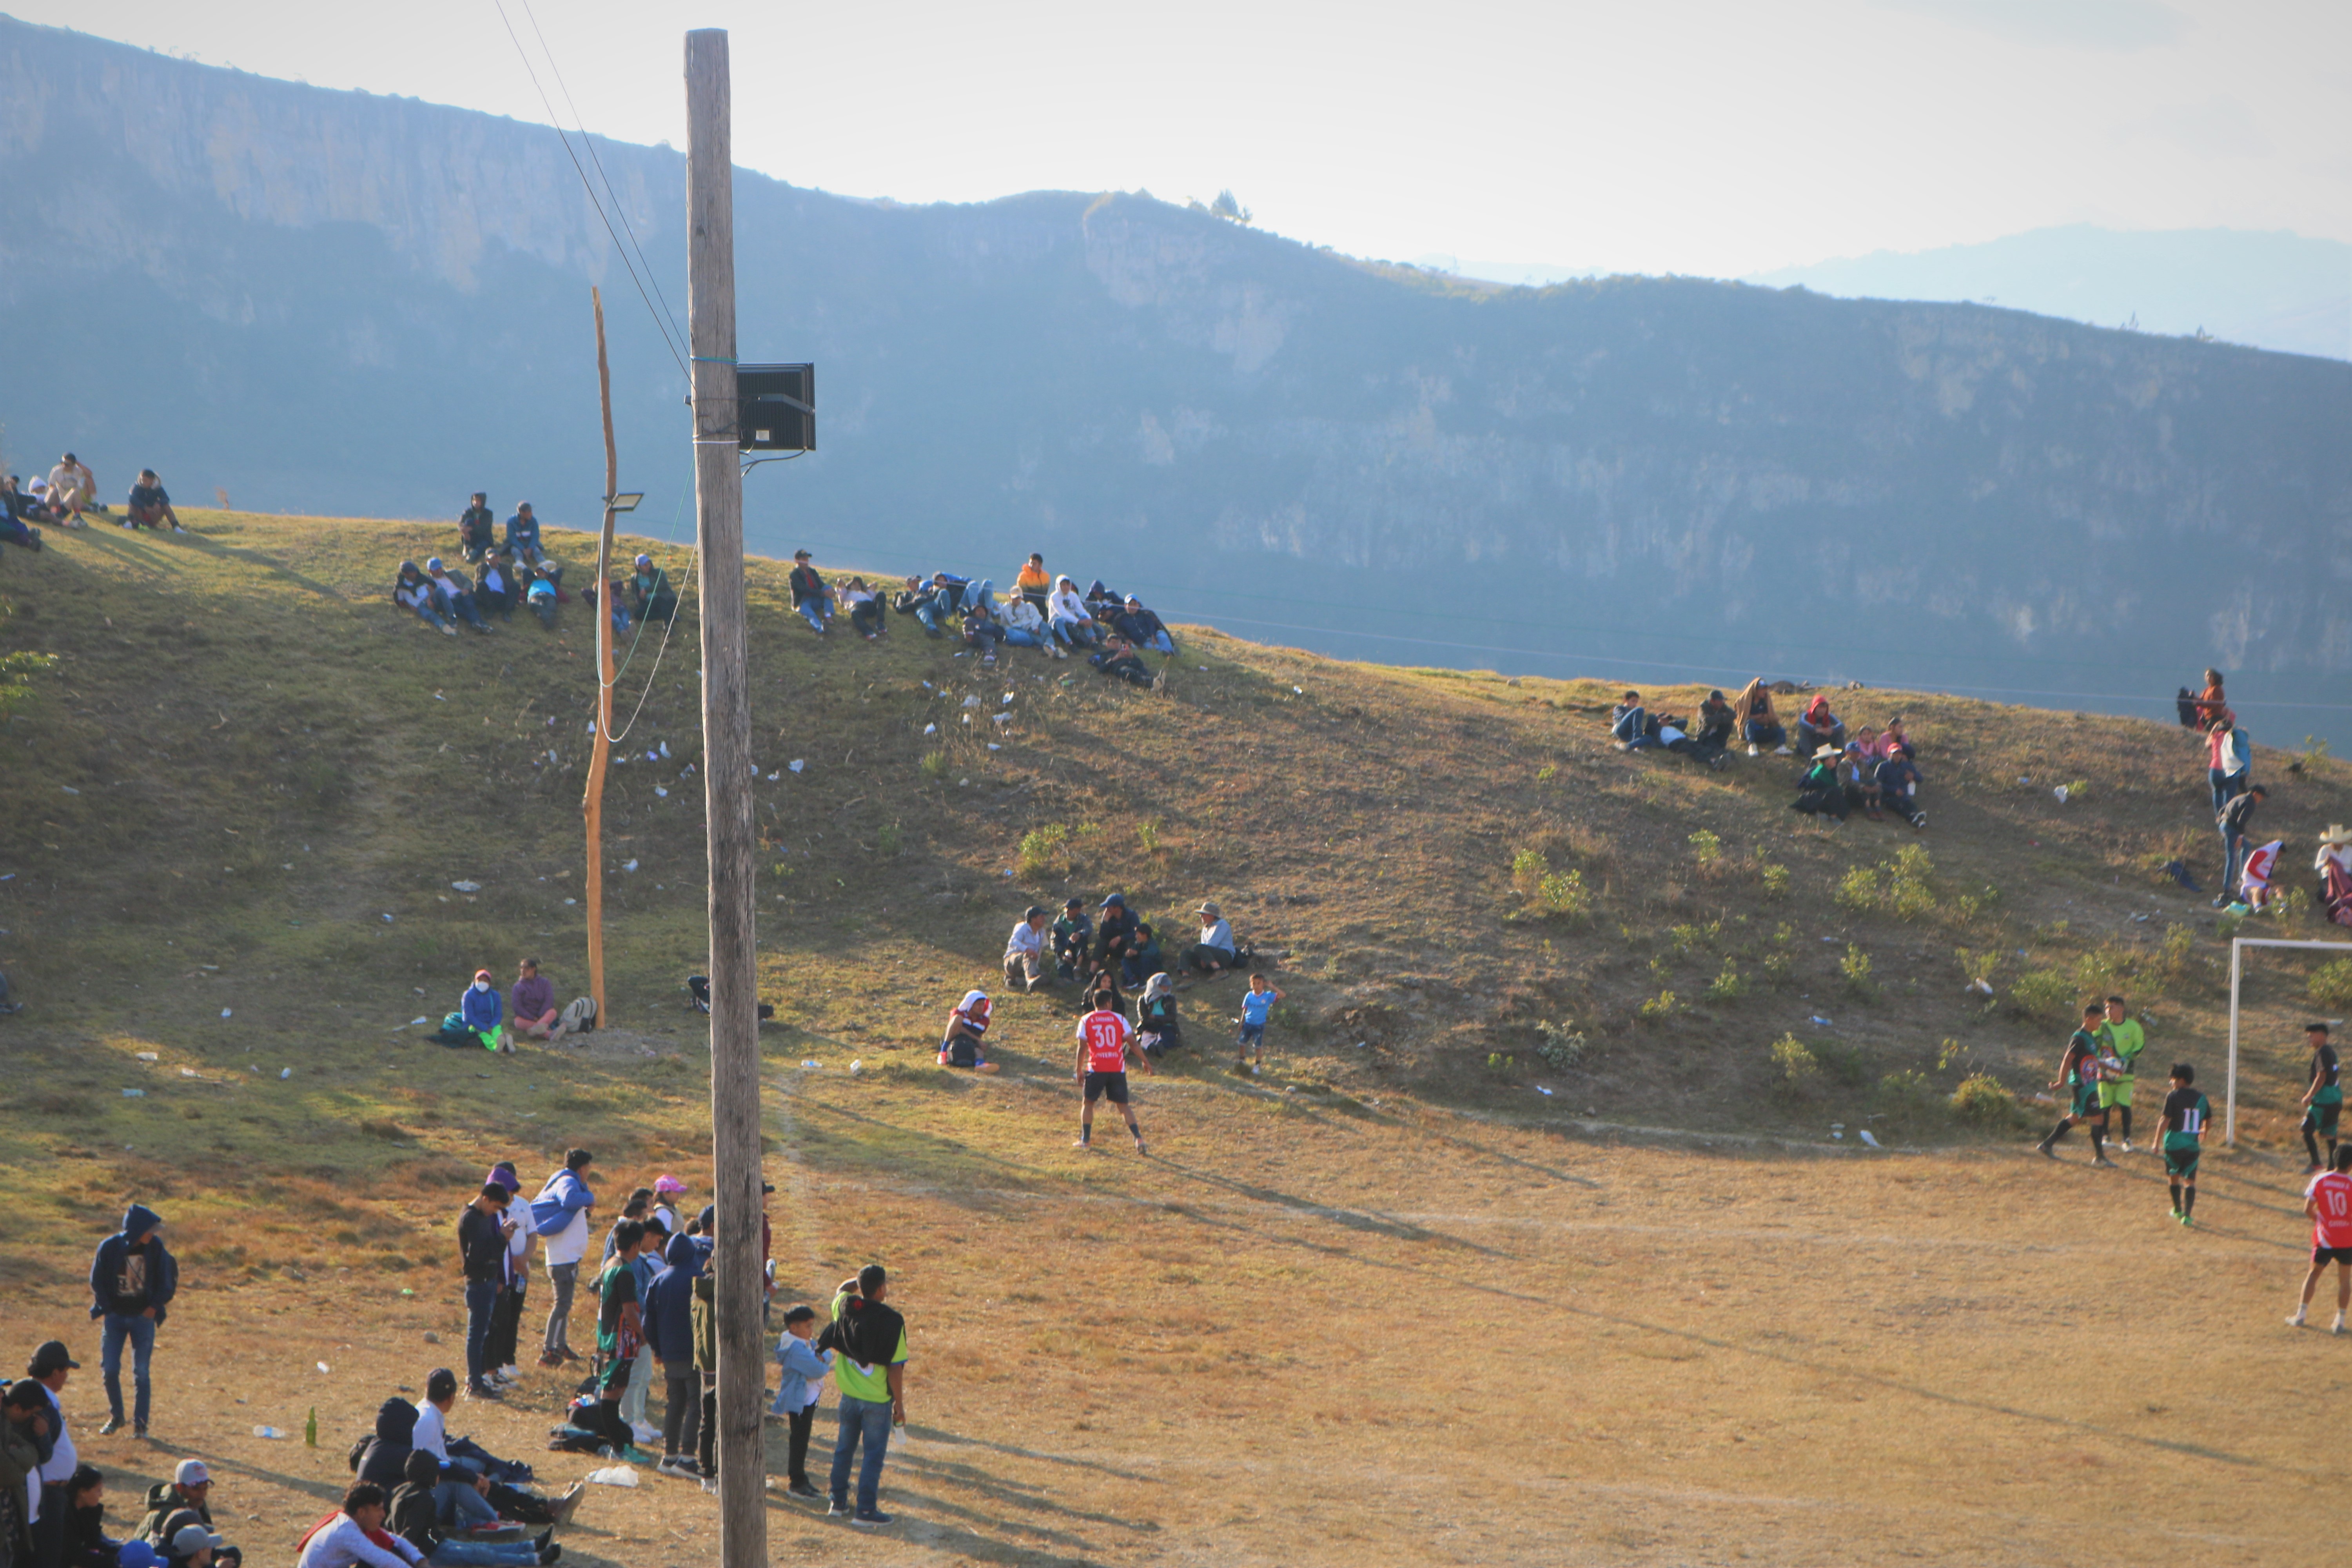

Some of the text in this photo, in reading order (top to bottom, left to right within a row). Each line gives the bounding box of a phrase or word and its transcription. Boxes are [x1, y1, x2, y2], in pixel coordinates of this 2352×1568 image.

[1092, 1024, 1116, 1048] 30
[2181, 1108, 2200, 1133] 11
[2325, 1190, 2347, 1216] 10
